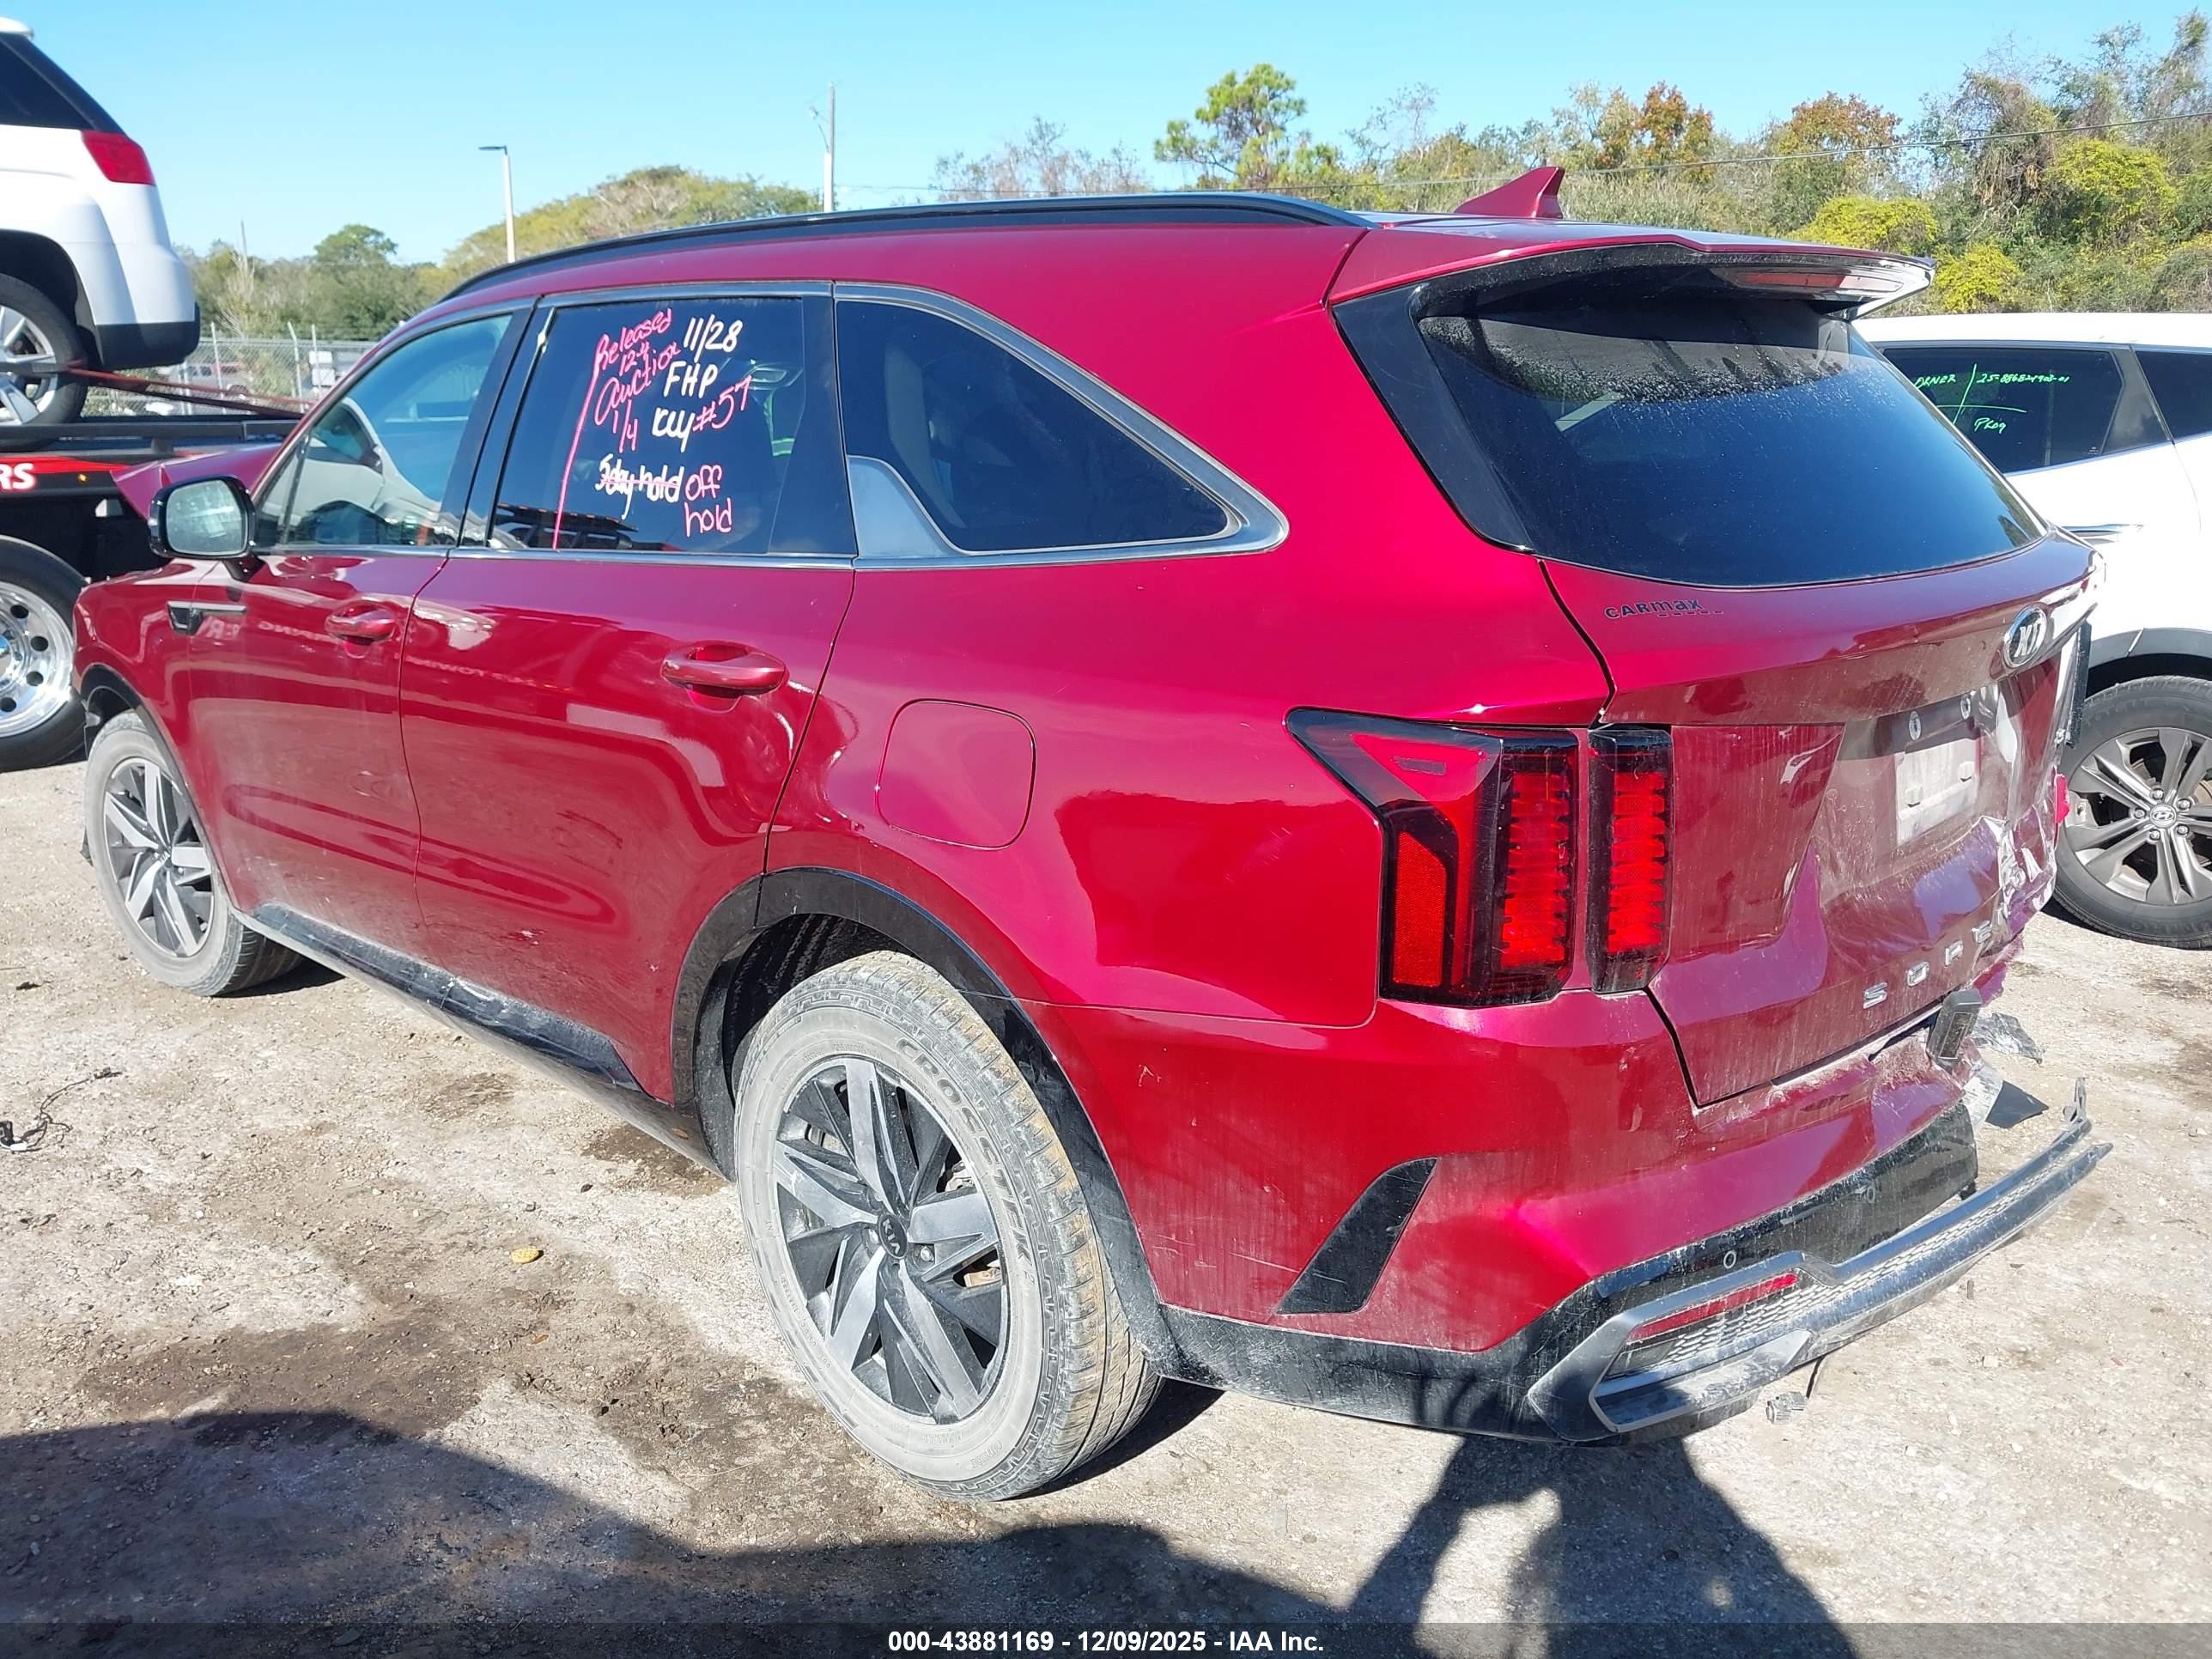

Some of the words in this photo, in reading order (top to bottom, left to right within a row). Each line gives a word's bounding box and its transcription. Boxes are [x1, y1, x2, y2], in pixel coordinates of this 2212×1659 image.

[684, 314, 744, 363] 11/28
[664, 361, 719, 398] FHP
[684, 497, 733, 538] hold
[882, 1218, 901, 1255] KIA
